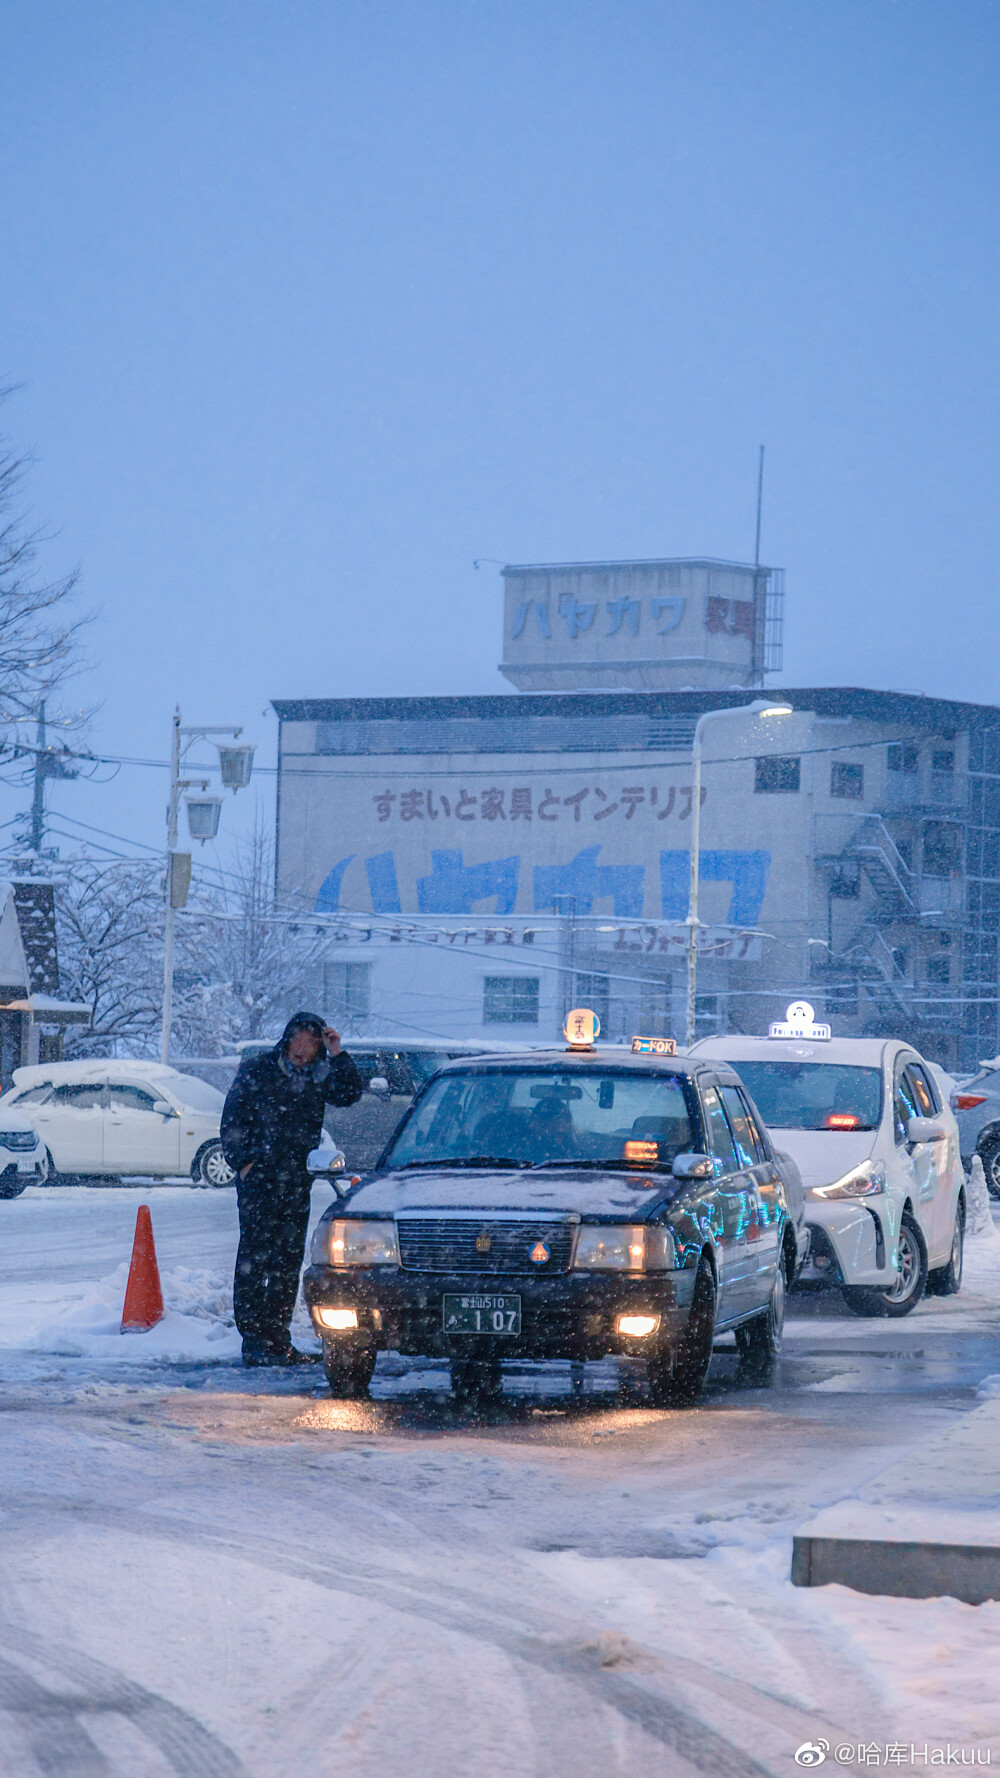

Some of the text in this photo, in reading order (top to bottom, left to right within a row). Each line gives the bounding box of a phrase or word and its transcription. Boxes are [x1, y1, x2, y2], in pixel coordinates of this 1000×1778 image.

[512, 594, 687, 640] ハヤカワ
[373, 787, 708, 822] すまいと家具とインテリア
[633, 1040, 673, 1053] カードOK
